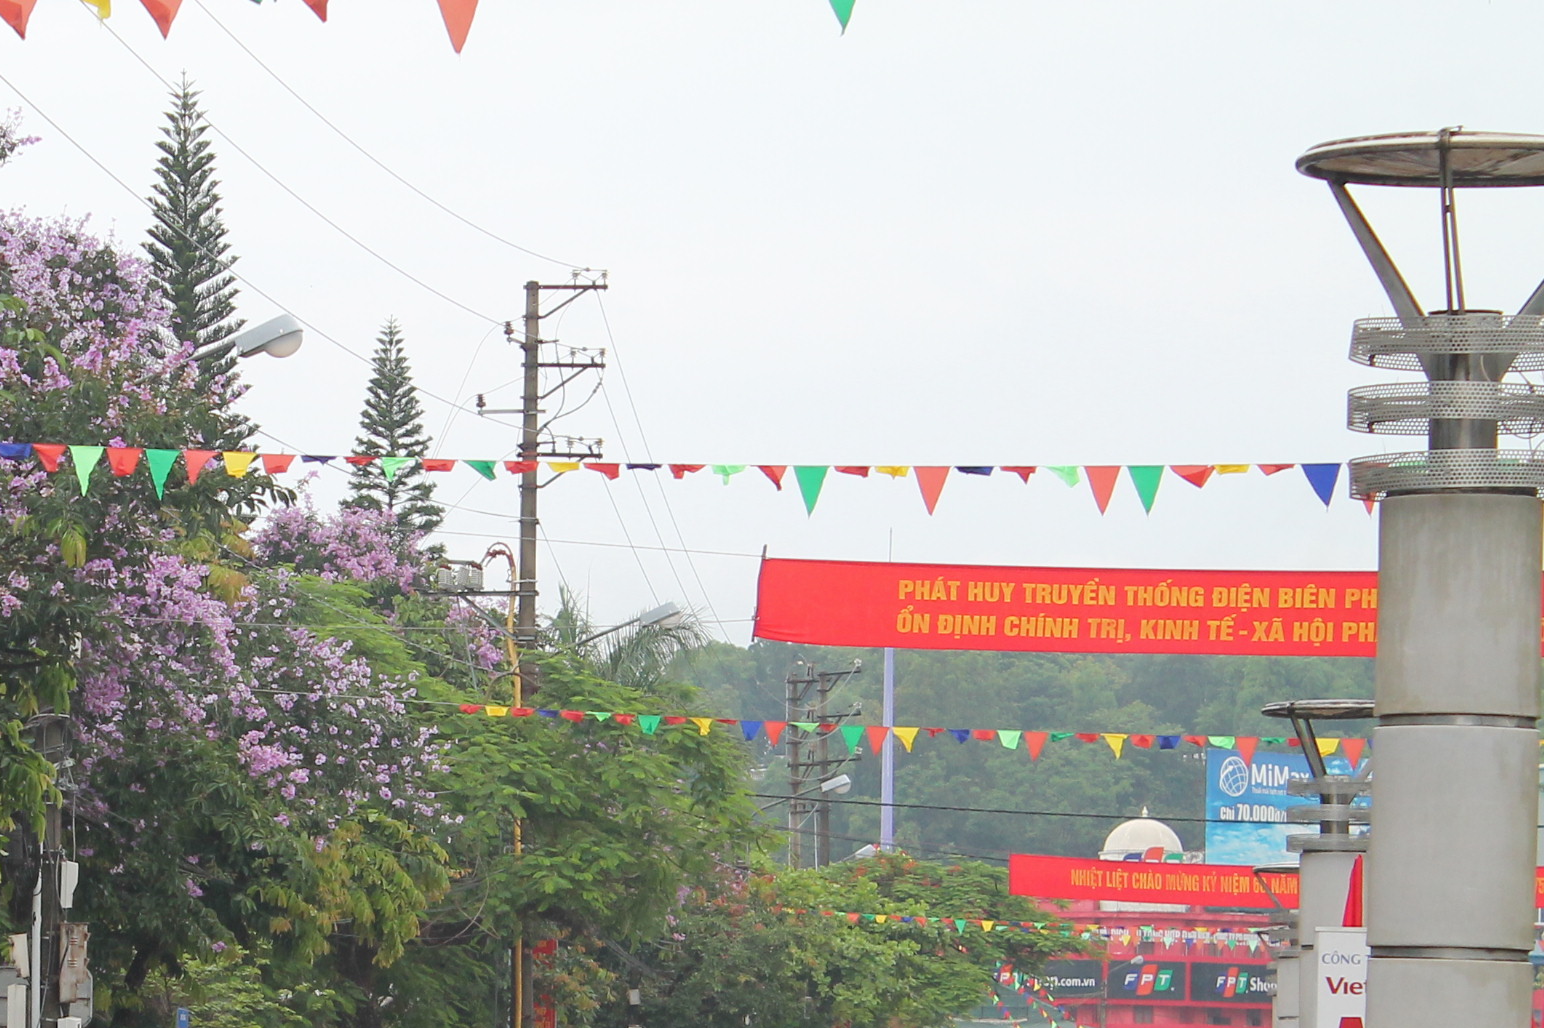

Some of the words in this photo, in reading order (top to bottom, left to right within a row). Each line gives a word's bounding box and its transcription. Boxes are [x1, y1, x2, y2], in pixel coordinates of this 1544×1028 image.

[898, 577, 960, 601] PHÁT
[968, 581, 1016, 602] HUY
[1023, 578, 1116, 605] TRUYỀN
[1124, 579, 1204, 607] THỐNG
[1212, 583, 1270, 612] ĐIỆN
[1278, 584, 1336, 608] BIÊN
[1345, 588, 1377, 609] PH
[896, 605, 930, 633] ỔN
[937, 614, 997, 639] ĐỊNH
[1004, 613, 1079, 638] CHÍNH
[1088, 618, 1132, 643] TRỊ,
[1140, 619, 1199, 640] KINH
[1207, 614, 1237, 641] TẾ
[1251, 618, 1285, 642] XÃ
[1293, 618, 1334, 646] HỘI
[1342, 622, 1377, 642] PH
[1071, 866, 1103, 889] NHIỆT
[1106, 868, 1129, 891] LIỆT
[1132, 869, 1162, 890] CHÀO
[1166, 870, 1200, 892] MỪNG
[1221, 873, 1250, 895] NIỆM
[1322, 950, 1361, 965] CÔNG
[1325, 976, 1366, 995] Vie
